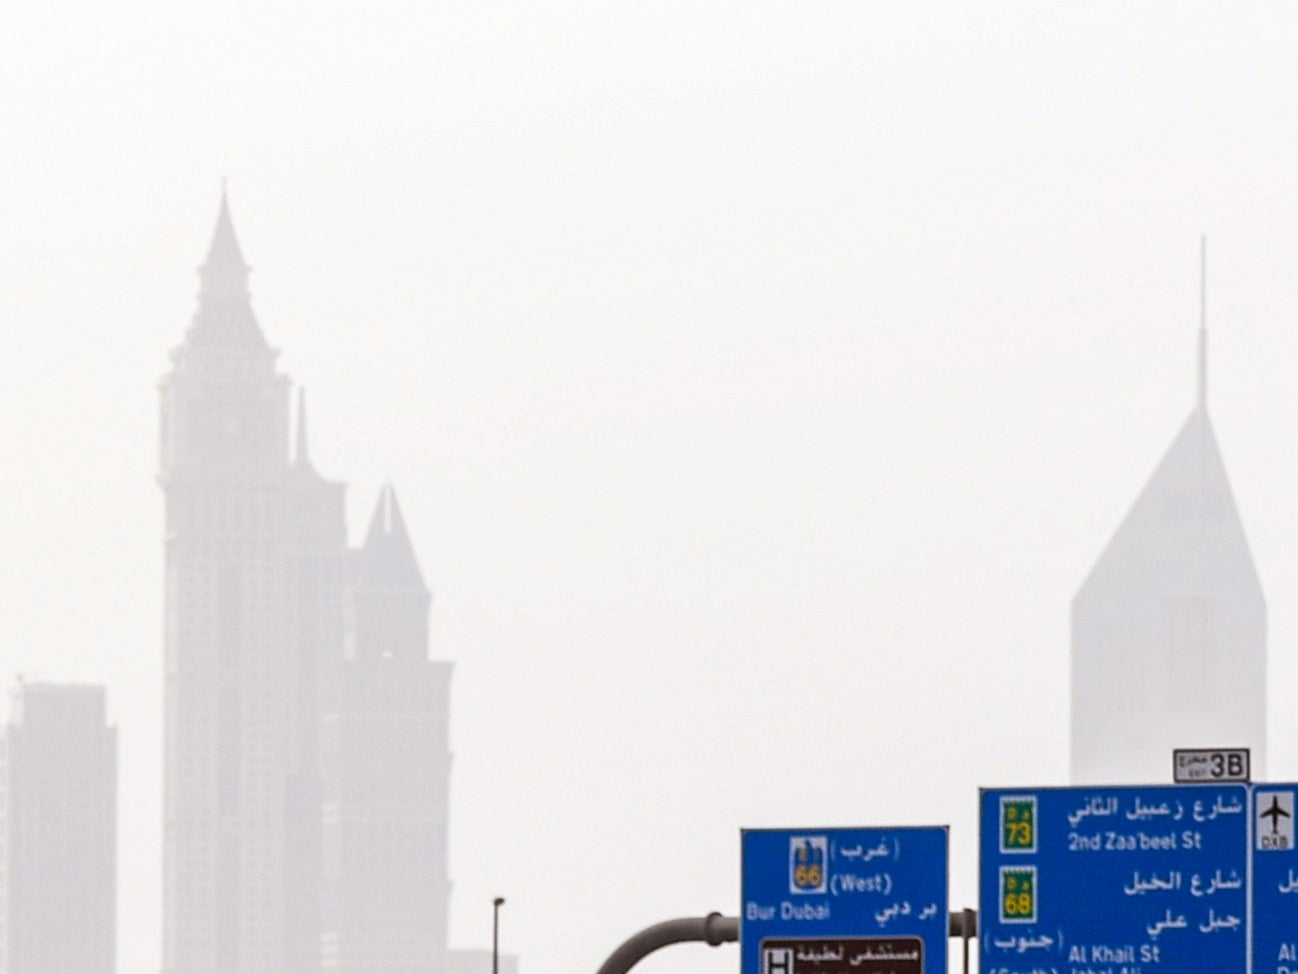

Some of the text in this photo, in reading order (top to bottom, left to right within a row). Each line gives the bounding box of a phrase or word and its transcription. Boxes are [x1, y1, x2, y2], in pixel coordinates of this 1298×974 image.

[1211, 753, 1243, 777] 3B
[1068, 795, 1242, 828] شارع زعبيل الثاني
[1006, 822, 1031, 844] 73
[1068, 830, 1202, 850] 2nd Zaa'beel St
[1261, 836, 1289, 848] DXB
[795, 864, 822, 887] 66
[830, 874, 892, 896] (West)
[1124, 868, 1242, 896] شارع الخيل
[747, 901, 830, 920] Bur Dubai
[875, 902, 937, 928] بر دبي
[1005, 893, 1031, 915] 68
[1147, 909, 1241, 940] جبل علي
[983, 928, 1064, 954] (جنوب)
[1278, 943, 1296, 961] Al
[1068, 945, 1160, 963] Al Khail St
